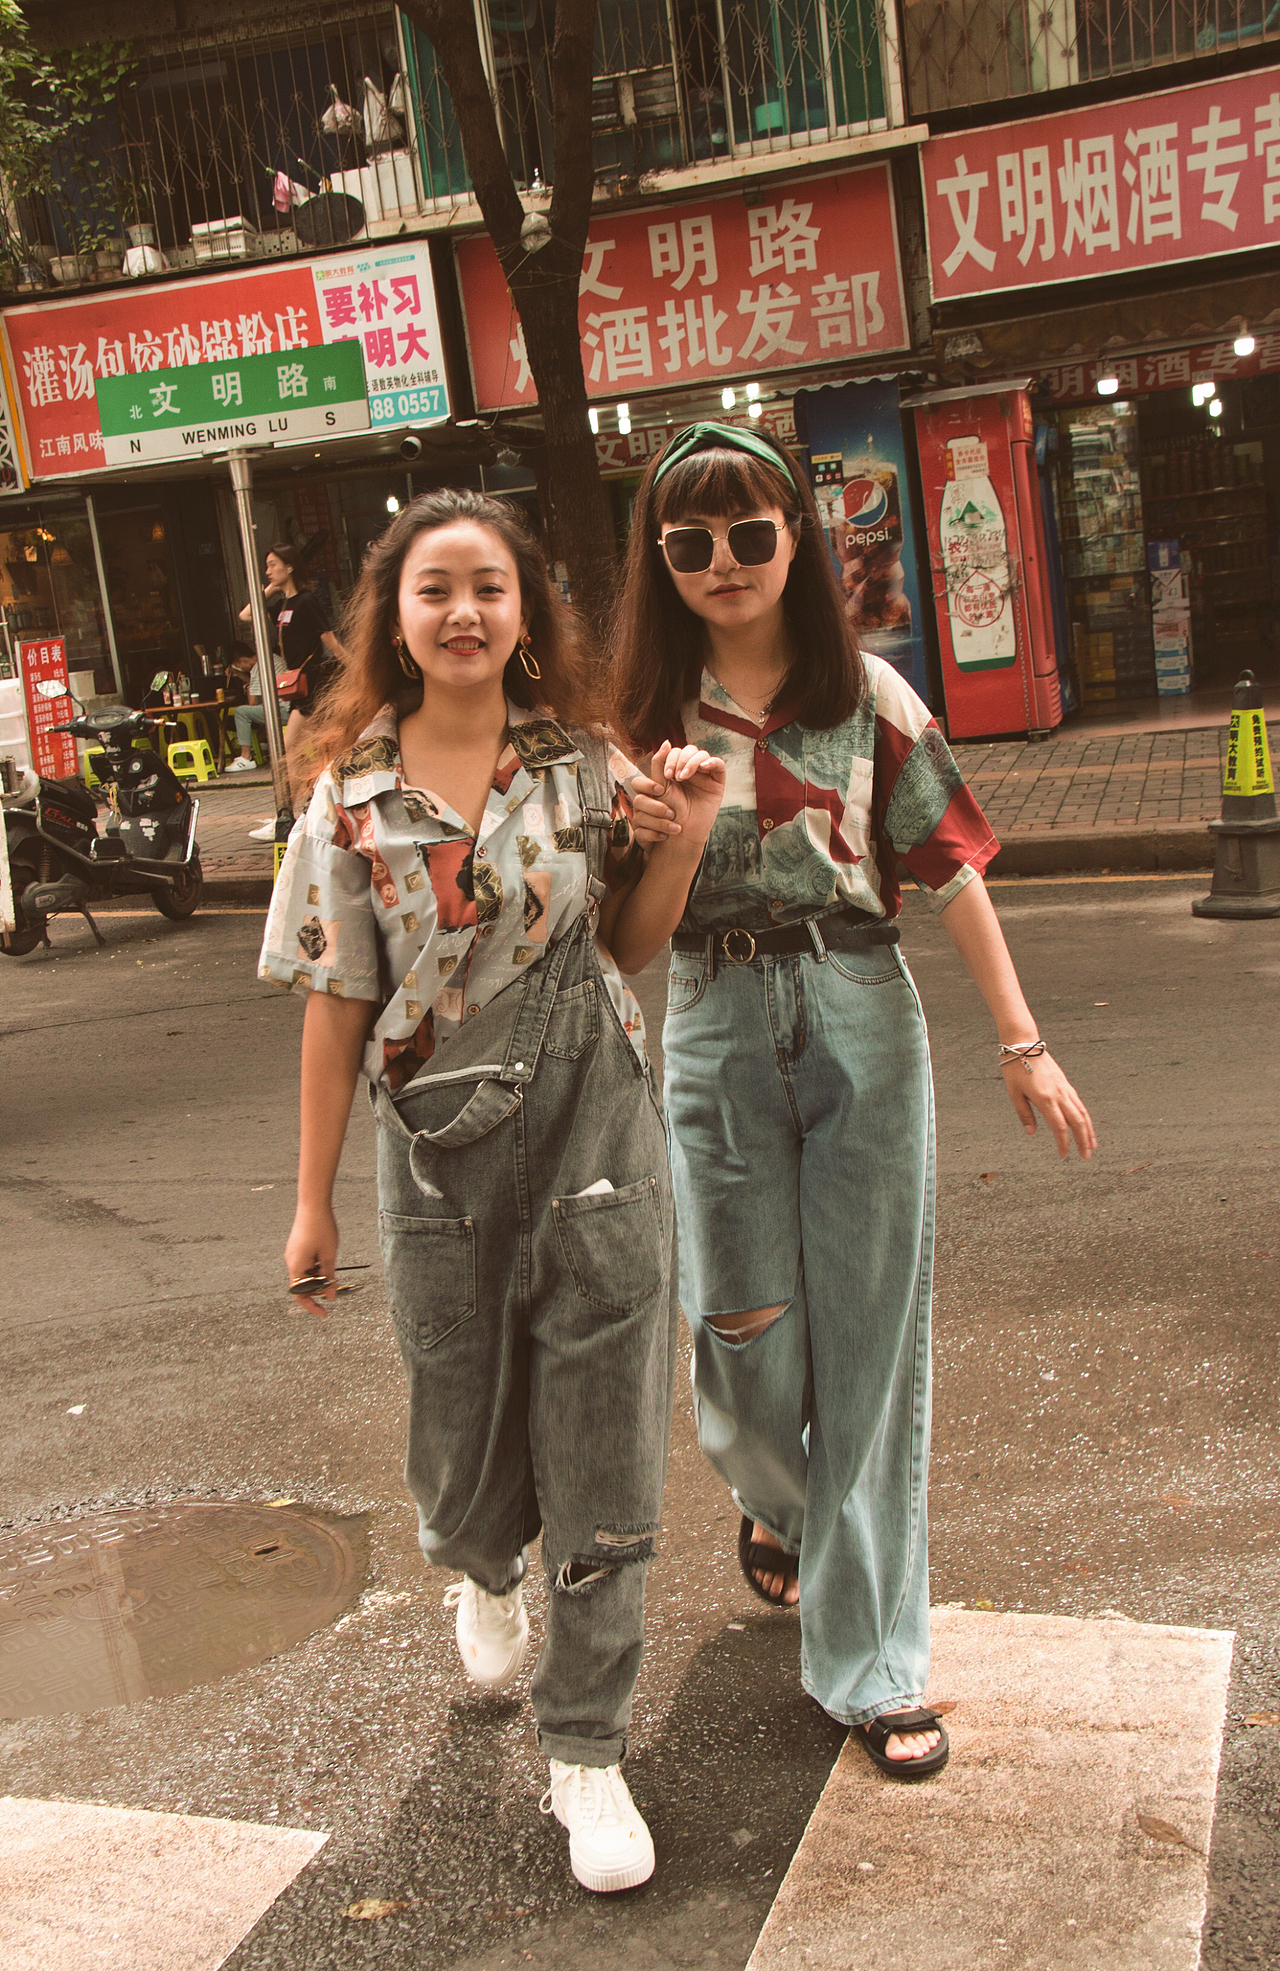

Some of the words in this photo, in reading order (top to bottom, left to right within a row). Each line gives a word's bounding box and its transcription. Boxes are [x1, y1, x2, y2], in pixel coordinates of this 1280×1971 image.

[322, 275, 421, 328] 要补习
[332, 323, 429, 368] 明大
[129, 405, 143, 419] 北
[149, 363, 308, 417] 文明路
[323, 375, 337, 392] 南
[369, 397, 395, 420] 88
[398, 390, 440, 416] 0557
[130, 440, 141, 453] N
[182, 422, 257, 446] WENMING
[269, 418, 288, 434] LU
[325, 411, 336, 426] S
[845, 527, 889, 549] pepsi
[27, 644, 62, 667] 价目表
